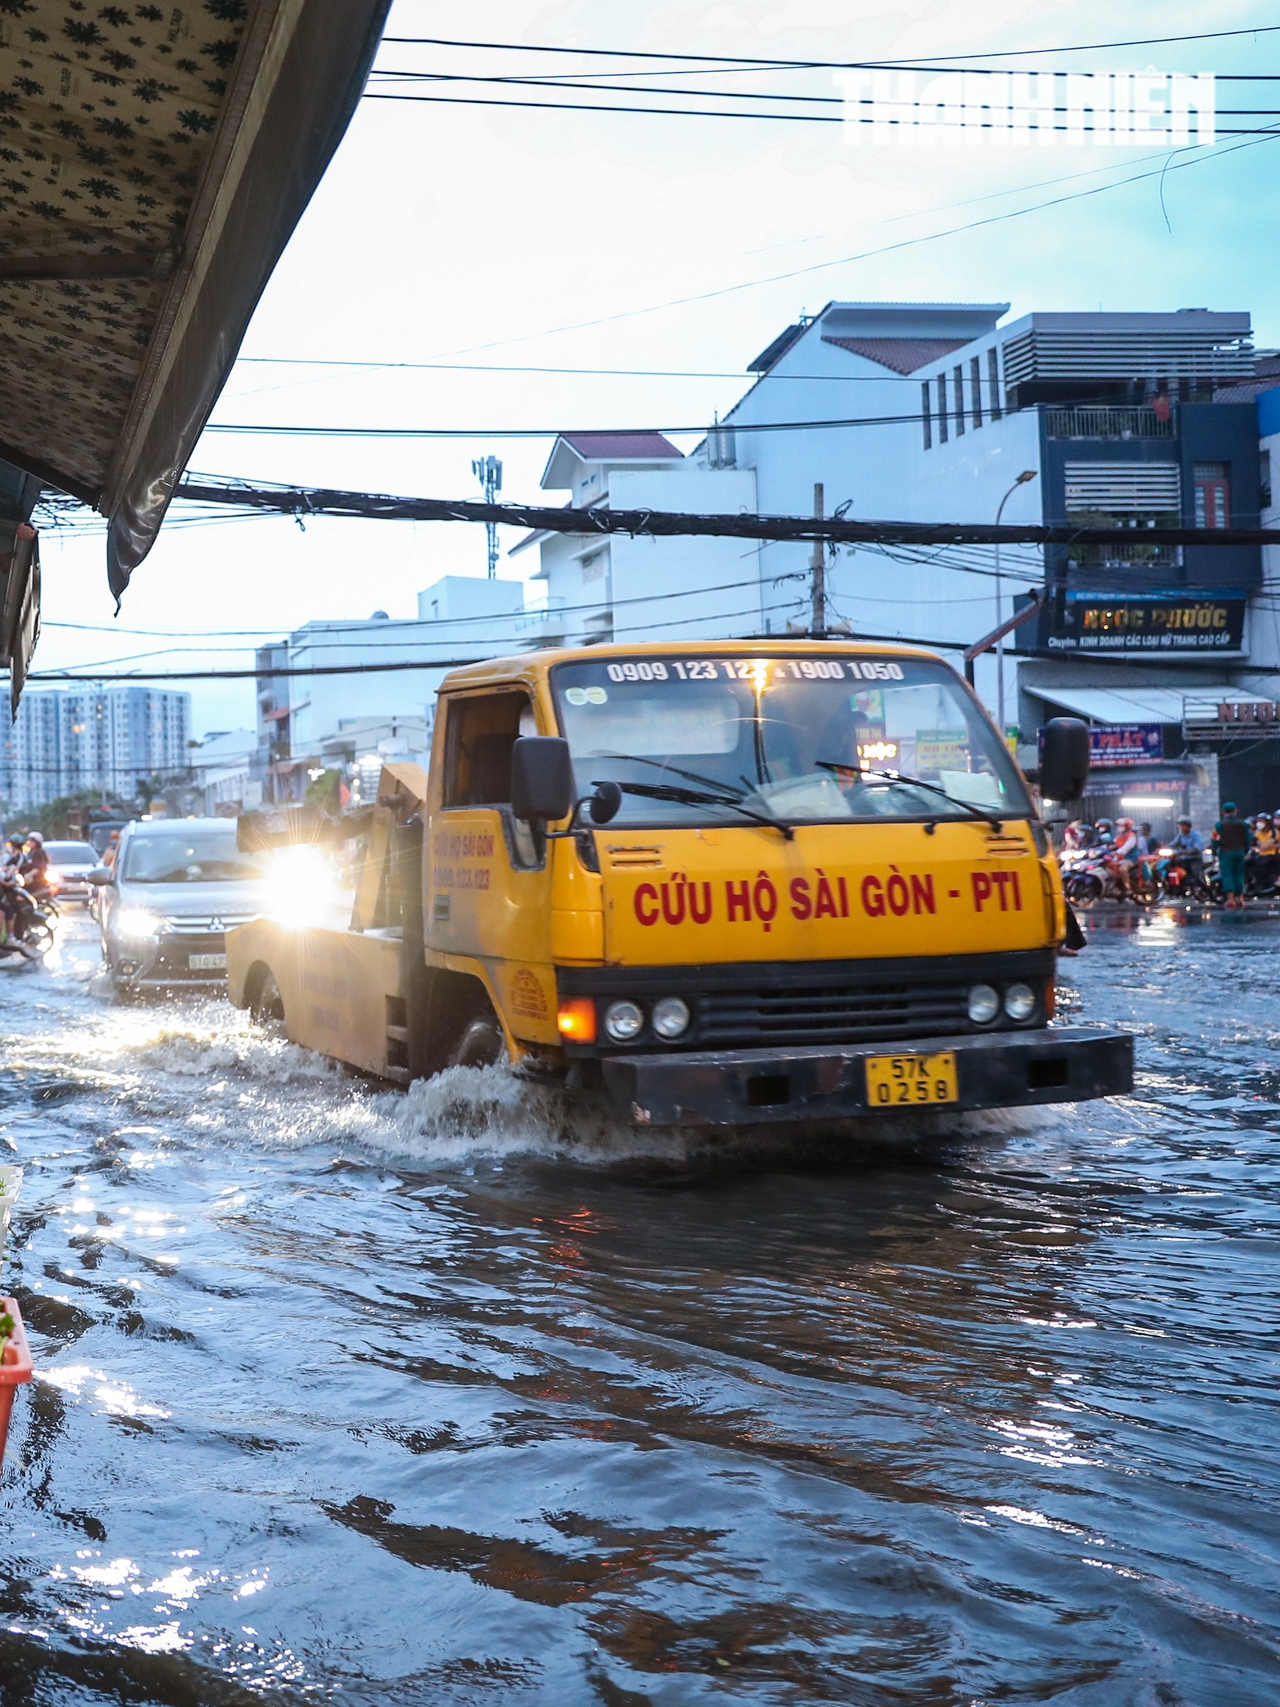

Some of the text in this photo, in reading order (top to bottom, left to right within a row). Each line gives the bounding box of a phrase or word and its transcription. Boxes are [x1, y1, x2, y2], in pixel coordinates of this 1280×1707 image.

[607, 661, 669, 682] 0909
[672, 661, 719, 680] 123
[787, 660, 846, 680] 1900
[847, 662, 905, 681] 1050
[633, 872, 712, 926] CỨU
[725, 870, 778, 932] HỘ
[790, 868, 849, 921] SÀI
[861, 865, 936, 917] GÒN
[971, 871, 1022, 913] PTI
[892, 1057, 931, 1078] 57K
[878, 1080, 948, 1103] 0258
